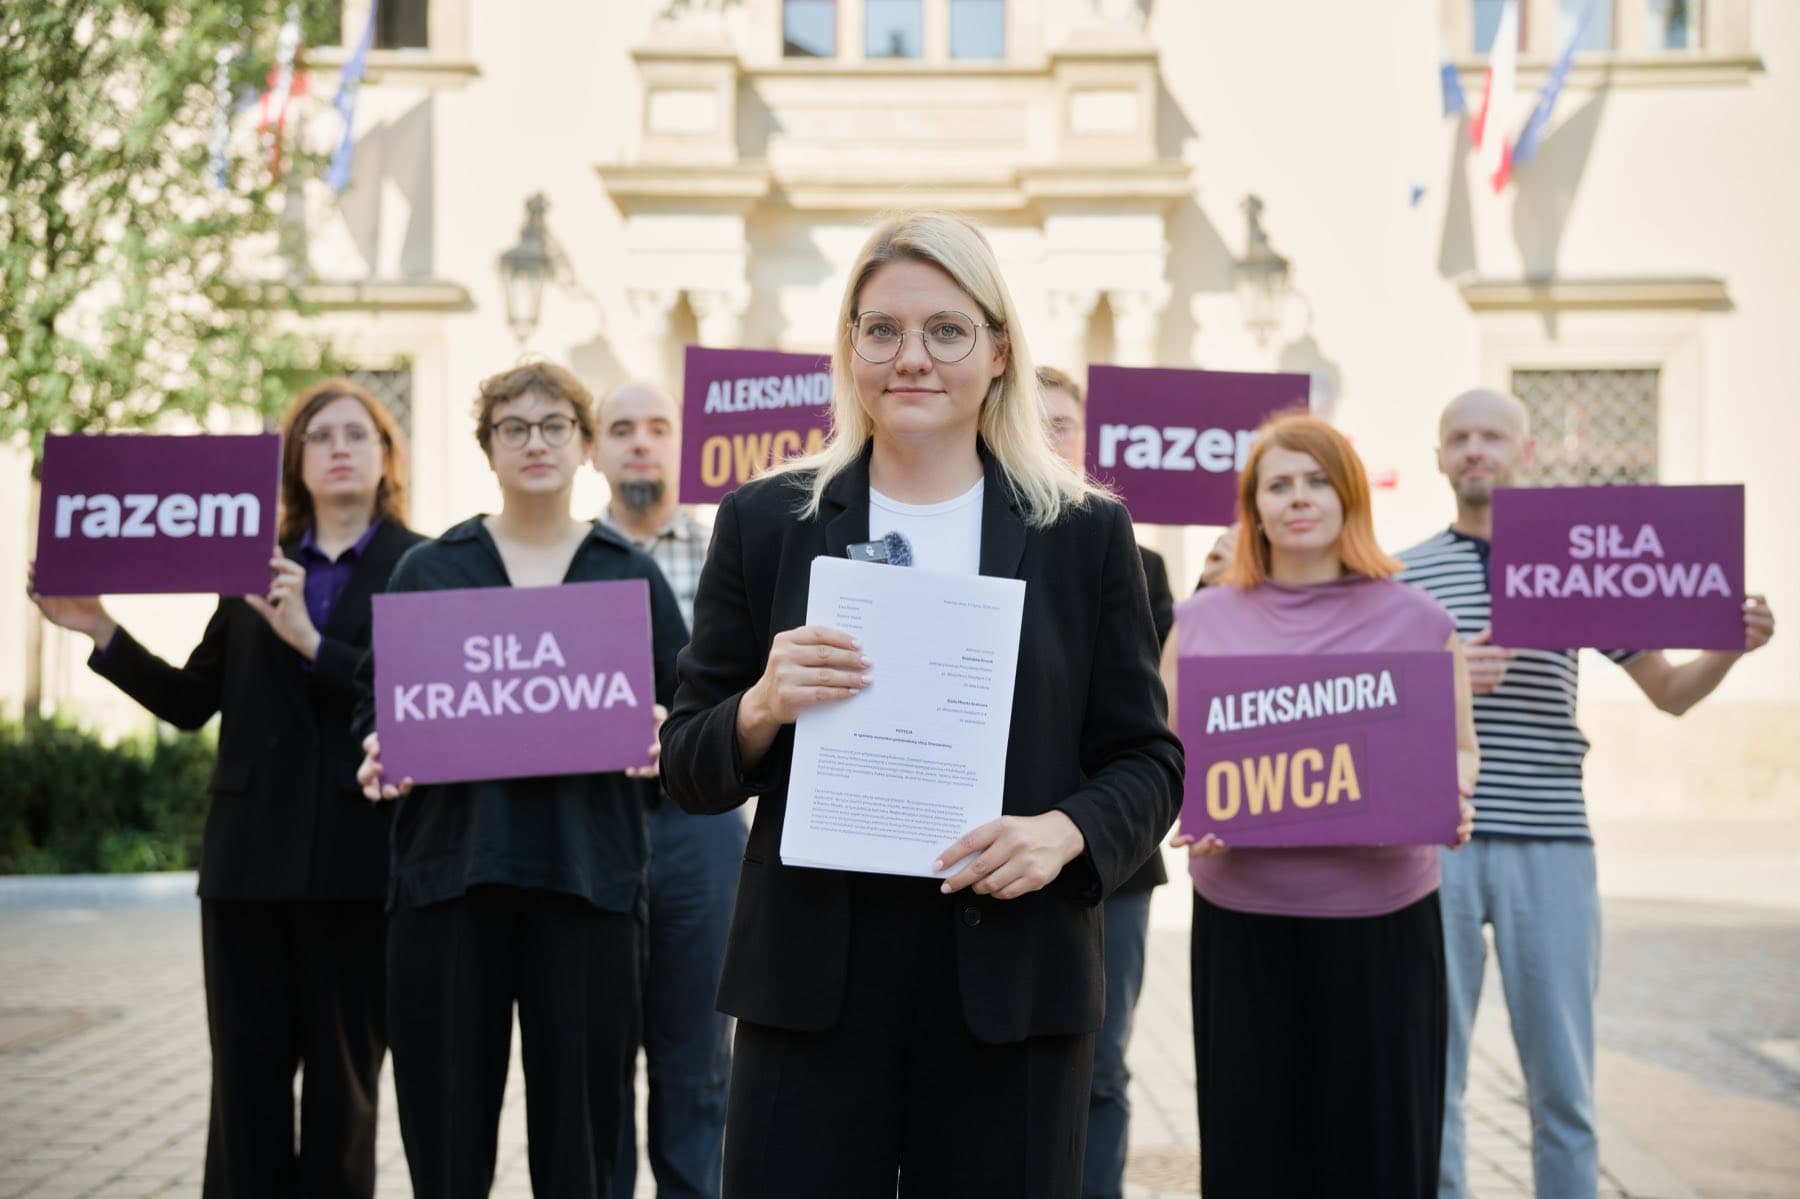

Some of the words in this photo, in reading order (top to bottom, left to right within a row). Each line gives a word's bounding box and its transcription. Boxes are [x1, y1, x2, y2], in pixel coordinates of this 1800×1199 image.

[703, 371, 834, 414] ALEKSAND
[55, 493, 260, 538] razem
[1568, 524, 1664, 558] SIŁA
[1505, 562, 1732, 598] KRAKOWA
[463, 631, 566, 673] SIŁA
[394, 670, 638, 721] KRAKOWA
[1206, 670, 1398, 734] ALEKSANDRA
[1206, 743, 1361, 822] OWCA
